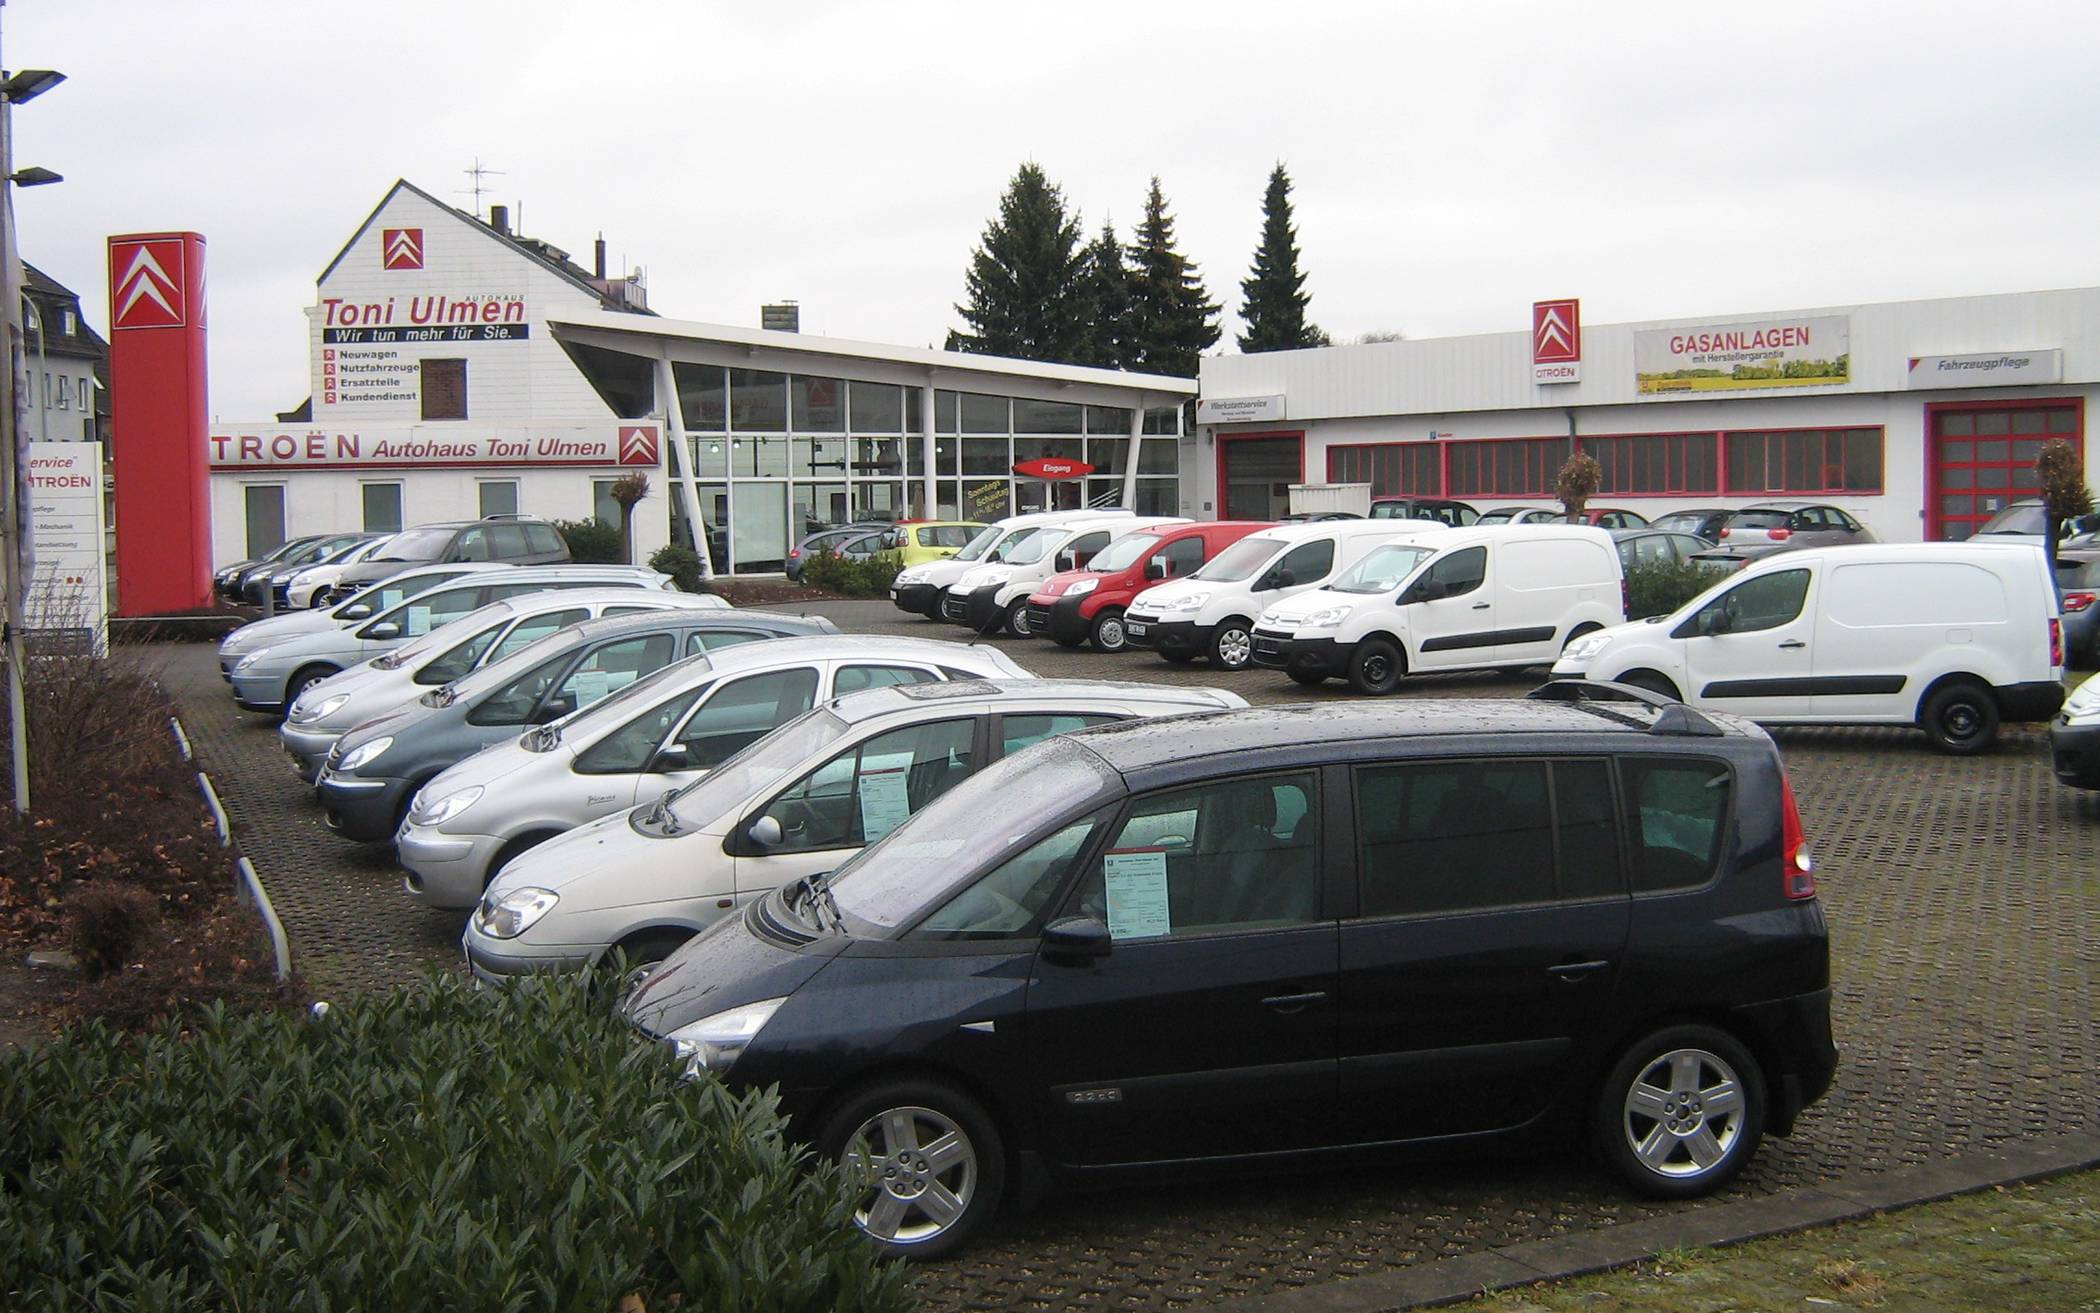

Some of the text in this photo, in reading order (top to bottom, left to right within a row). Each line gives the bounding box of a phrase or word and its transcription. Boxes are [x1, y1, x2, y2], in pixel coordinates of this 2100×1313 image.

[464, 294, 525, 302] AUTOHAUS
[322, 296, 525, 326] Toni Ulmen
[335, 325, 512, 342] Wir tun mehr für Sie.
[1669, 326, 1810, 354] GASANLAGEN
[340, 350, 398, 360] Neuwagen
[340, 364, 420, 374] Nutzfahrzeuge
[1937, 357, 2030, 371] Fahrzeugpflege
[340, 377, 400, 388] Ersatzteile
[341, 391, 417, 402] Kundendienst
[372, 439, 477, 458] Autohaus
[486, 438, 530, 457] Toni
[537, 437, 606, 456] Ulmen
[1043, 463, 1071, 473] Eingang
